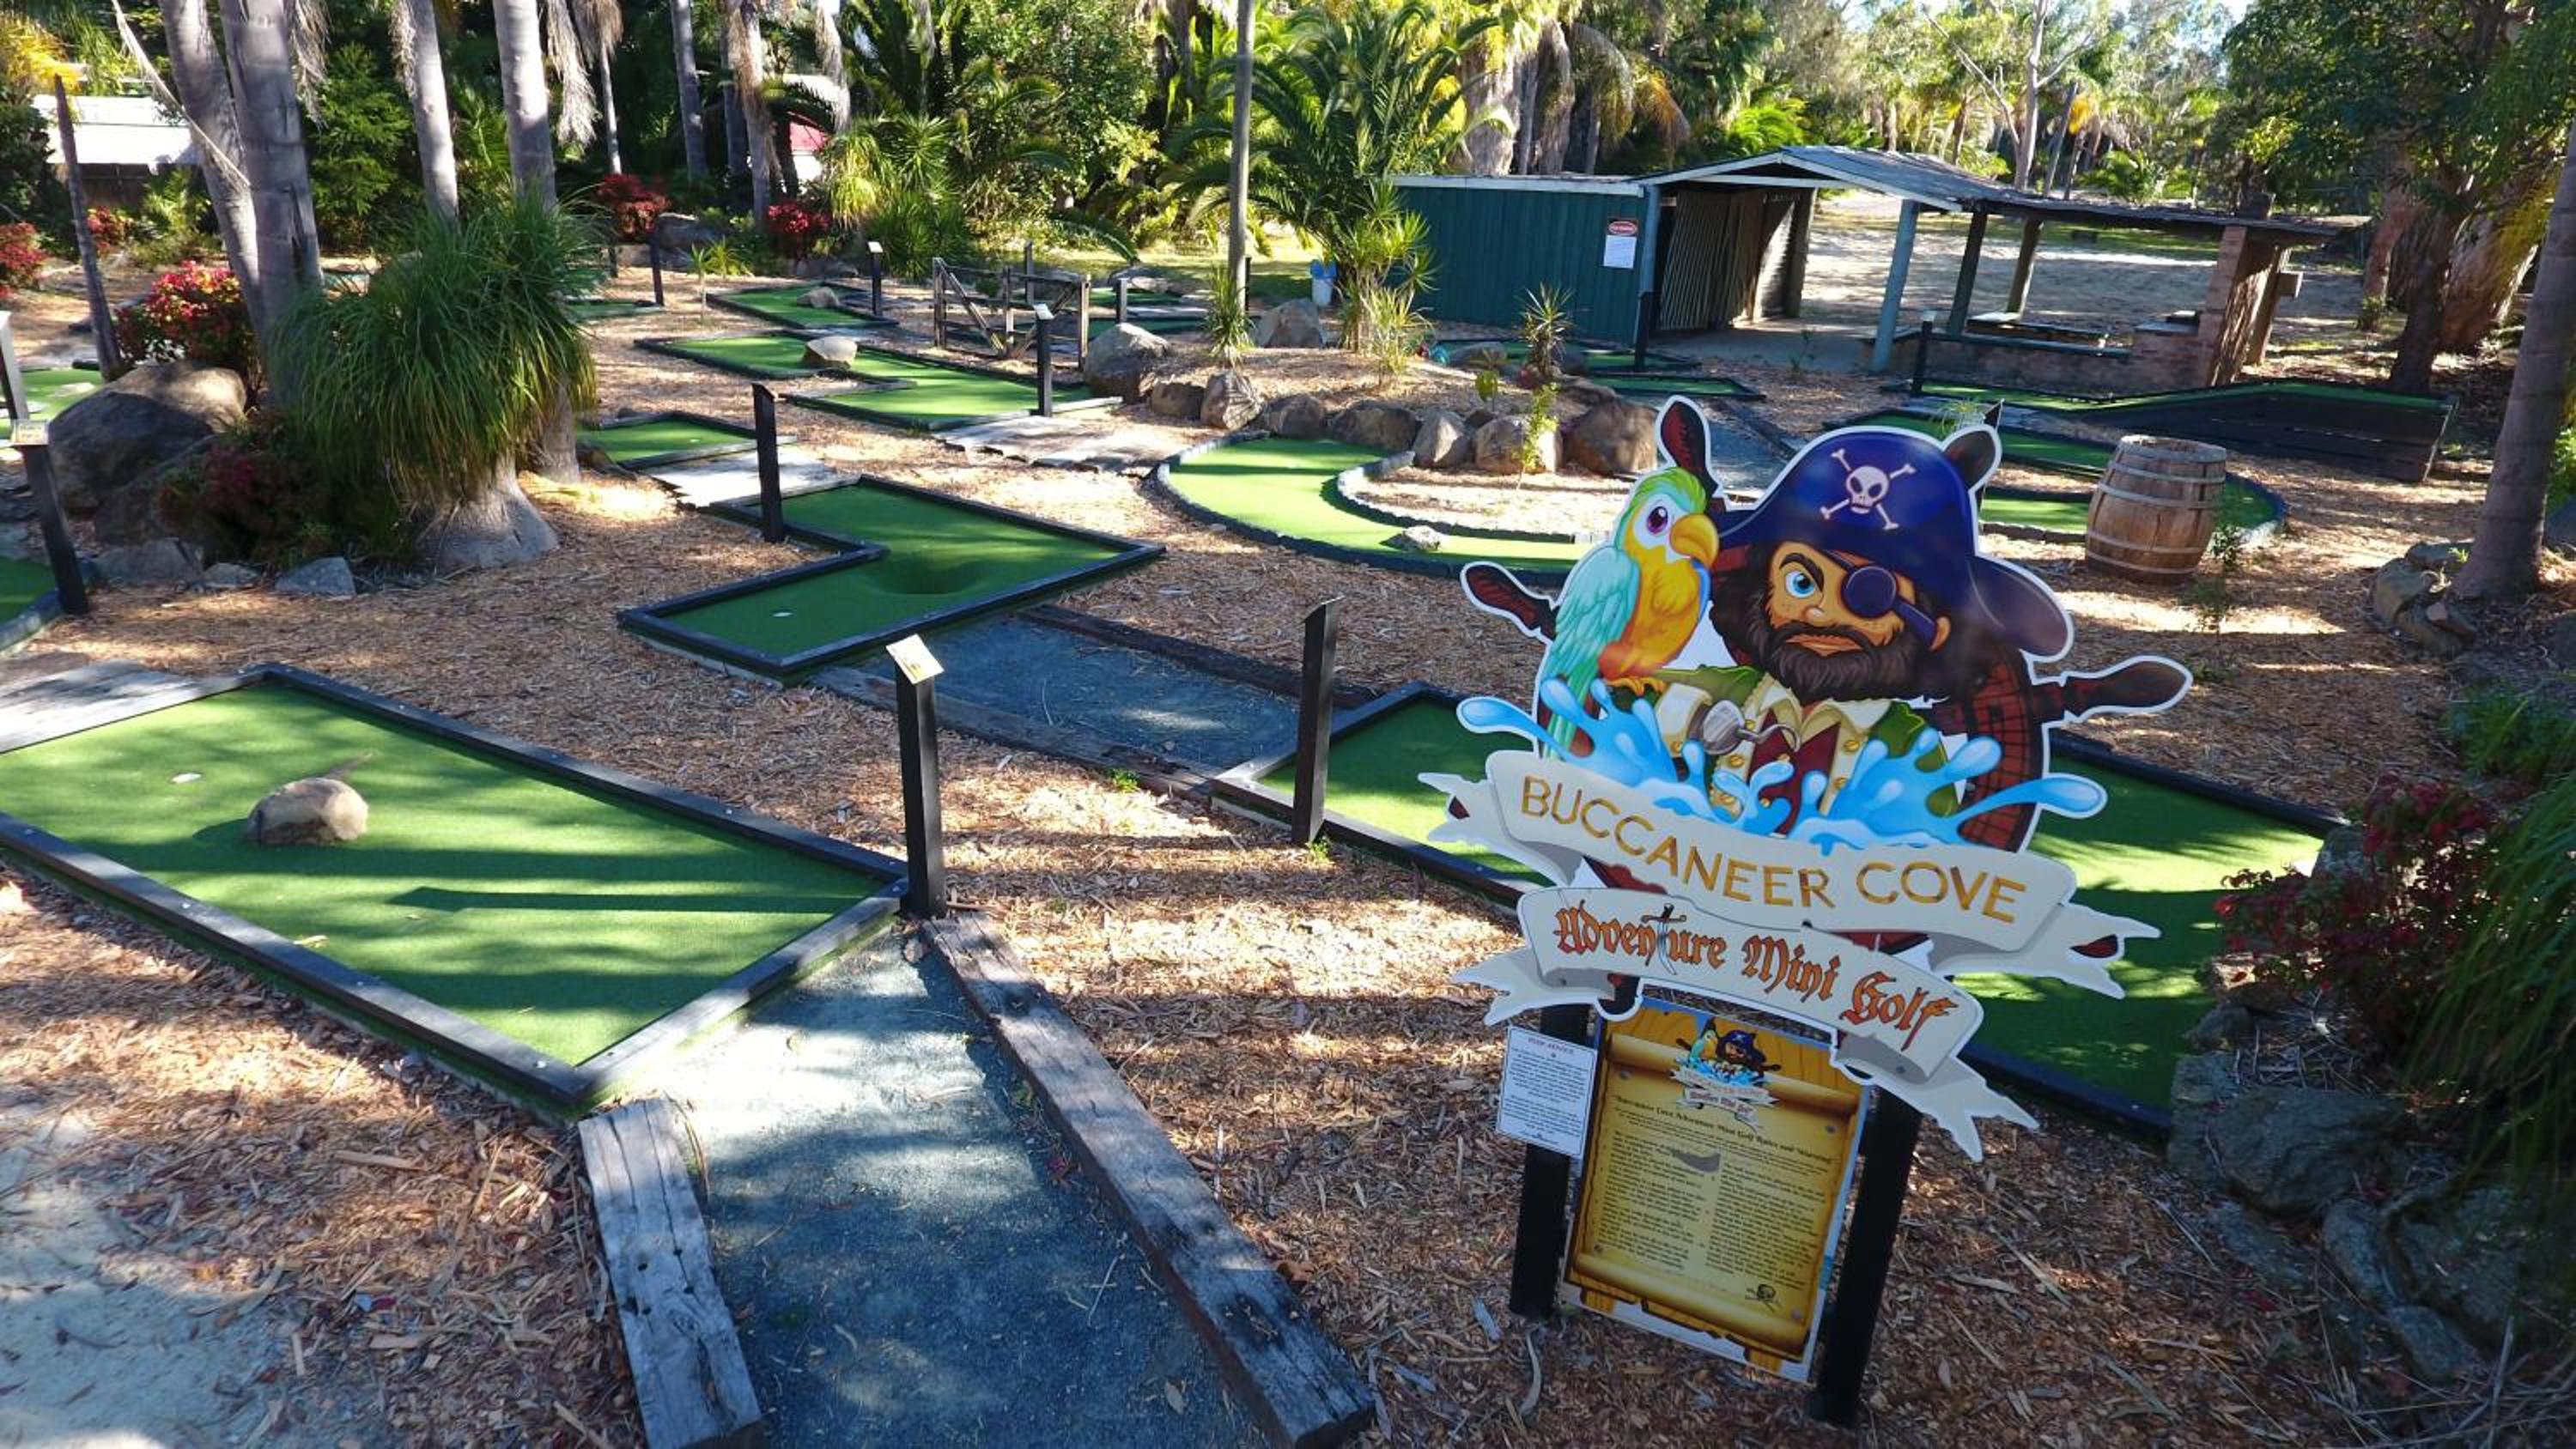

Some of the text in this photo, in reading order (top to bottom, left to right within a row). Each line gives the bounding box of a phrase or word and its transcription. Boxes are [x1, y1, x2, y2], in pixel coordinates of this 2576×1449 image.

[1520, 774, 2026, 923] BUCCANEER COVE
[1552, 900, 1959, 1052] Adventure Mini Golf
